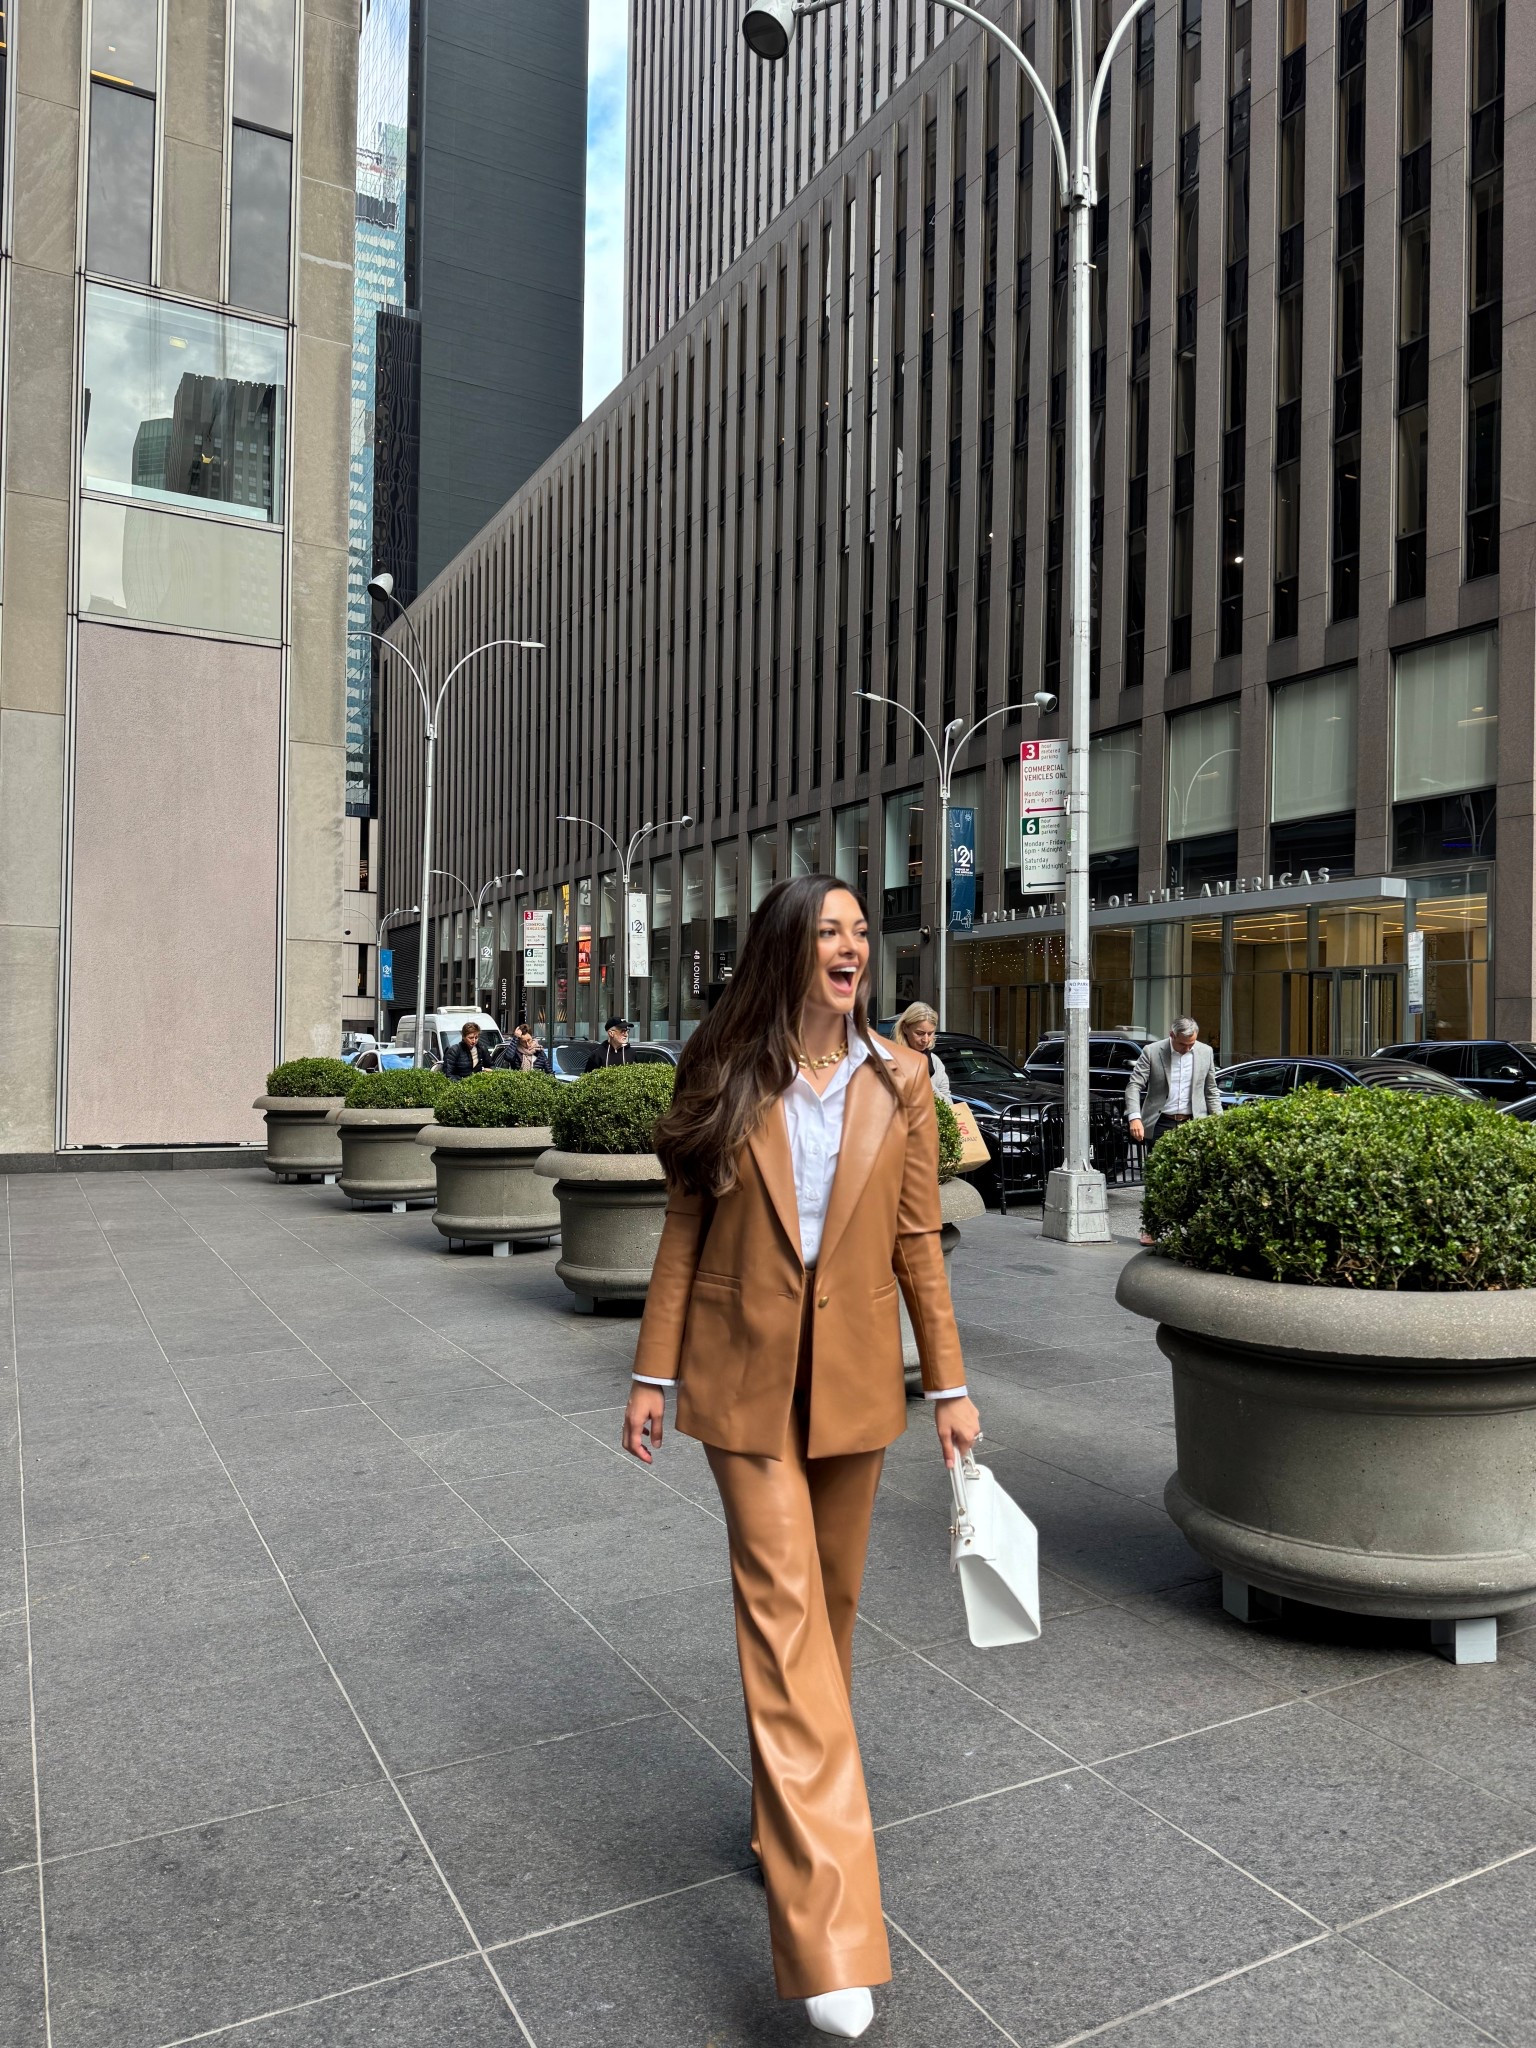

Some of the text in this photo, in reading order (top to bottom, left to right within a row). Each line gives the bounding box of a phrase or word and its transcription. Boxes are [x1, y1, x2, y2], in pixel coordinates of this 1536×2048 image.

[1026, 744, 1036, 760] 3
[1024, 764, 1065, 774] COMMERCIAL
[1024, 773, 1054, 781] VEHICLES
[1026, 819, 1036, 835] 6
[1041, 846, 1063, 854] Midnight
[982, 909, 1016, 924] 1221
[1108, 893, 1133, 908] OF
[1146, 886, 1185, 904] THE
[1201, 867, 1330, 897] AMERICAS
[526, 912, 532, 920] 3
[526, 949, 532, 957] 6
